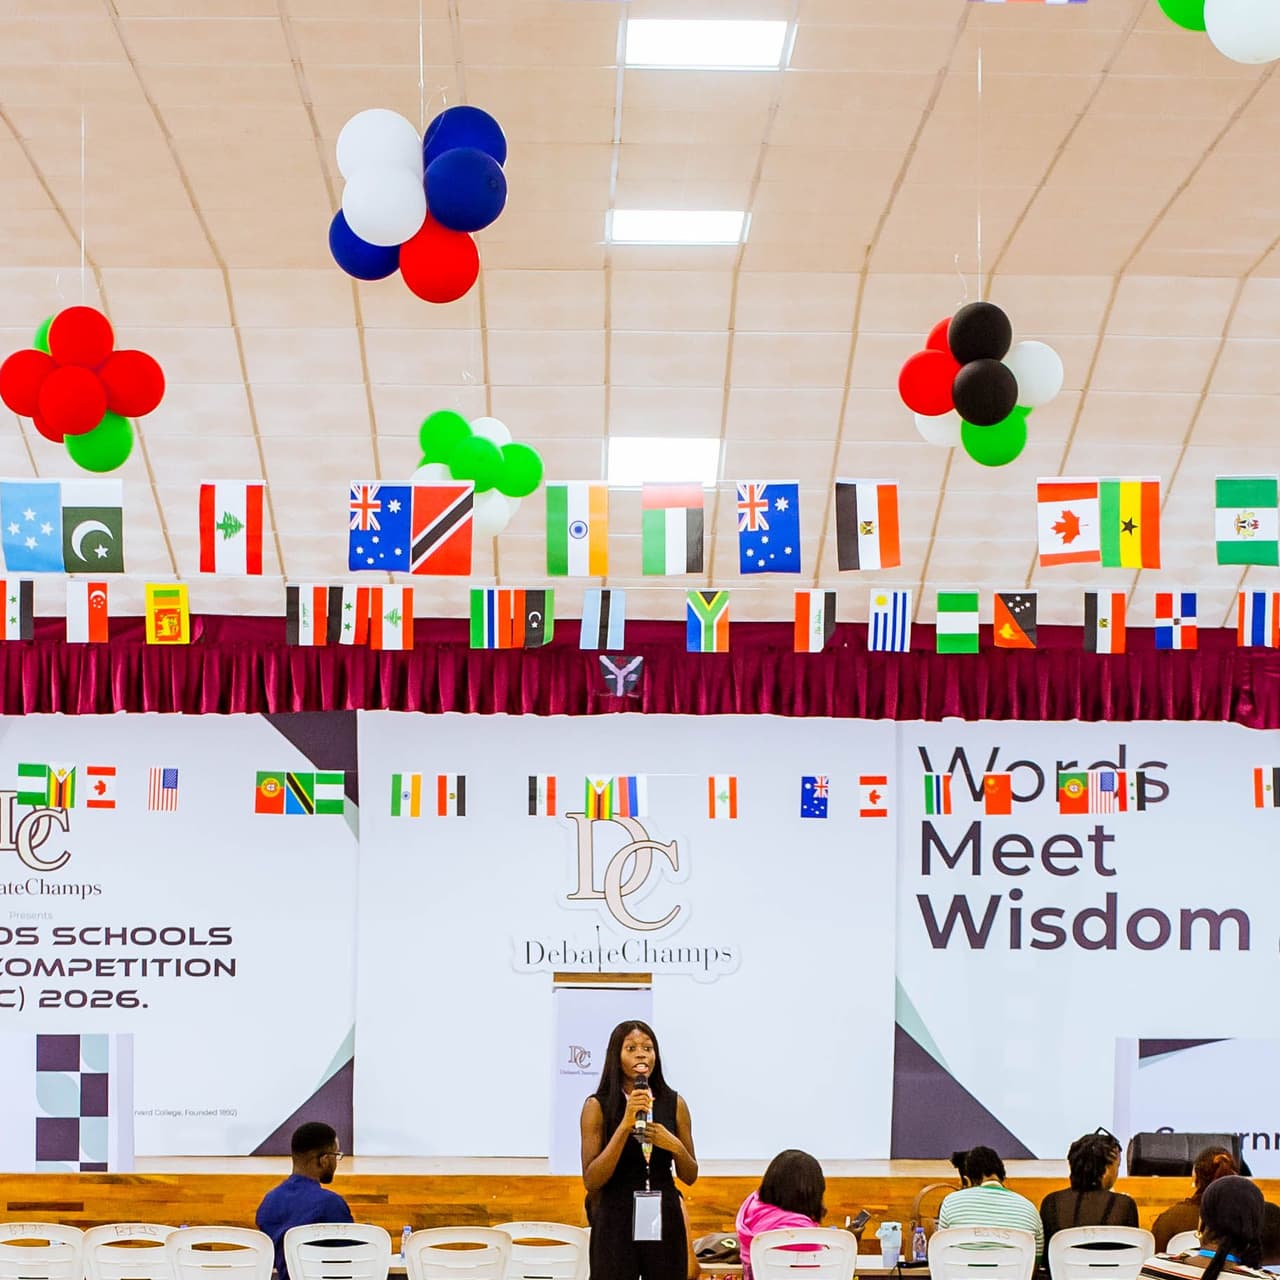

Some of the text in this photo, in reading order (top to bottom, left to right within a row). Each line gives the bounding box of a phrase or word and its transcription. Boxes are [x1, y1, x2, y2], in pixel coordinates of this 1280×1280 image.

[921, 820, 1118, 877] Meet
[9, 911, 54, 920] Presents
[916, 888, 1251, 951] Wisdom
[51, 926, 233, 946] SCHOOLS
[38, 989, 149, 1010] 2026.
